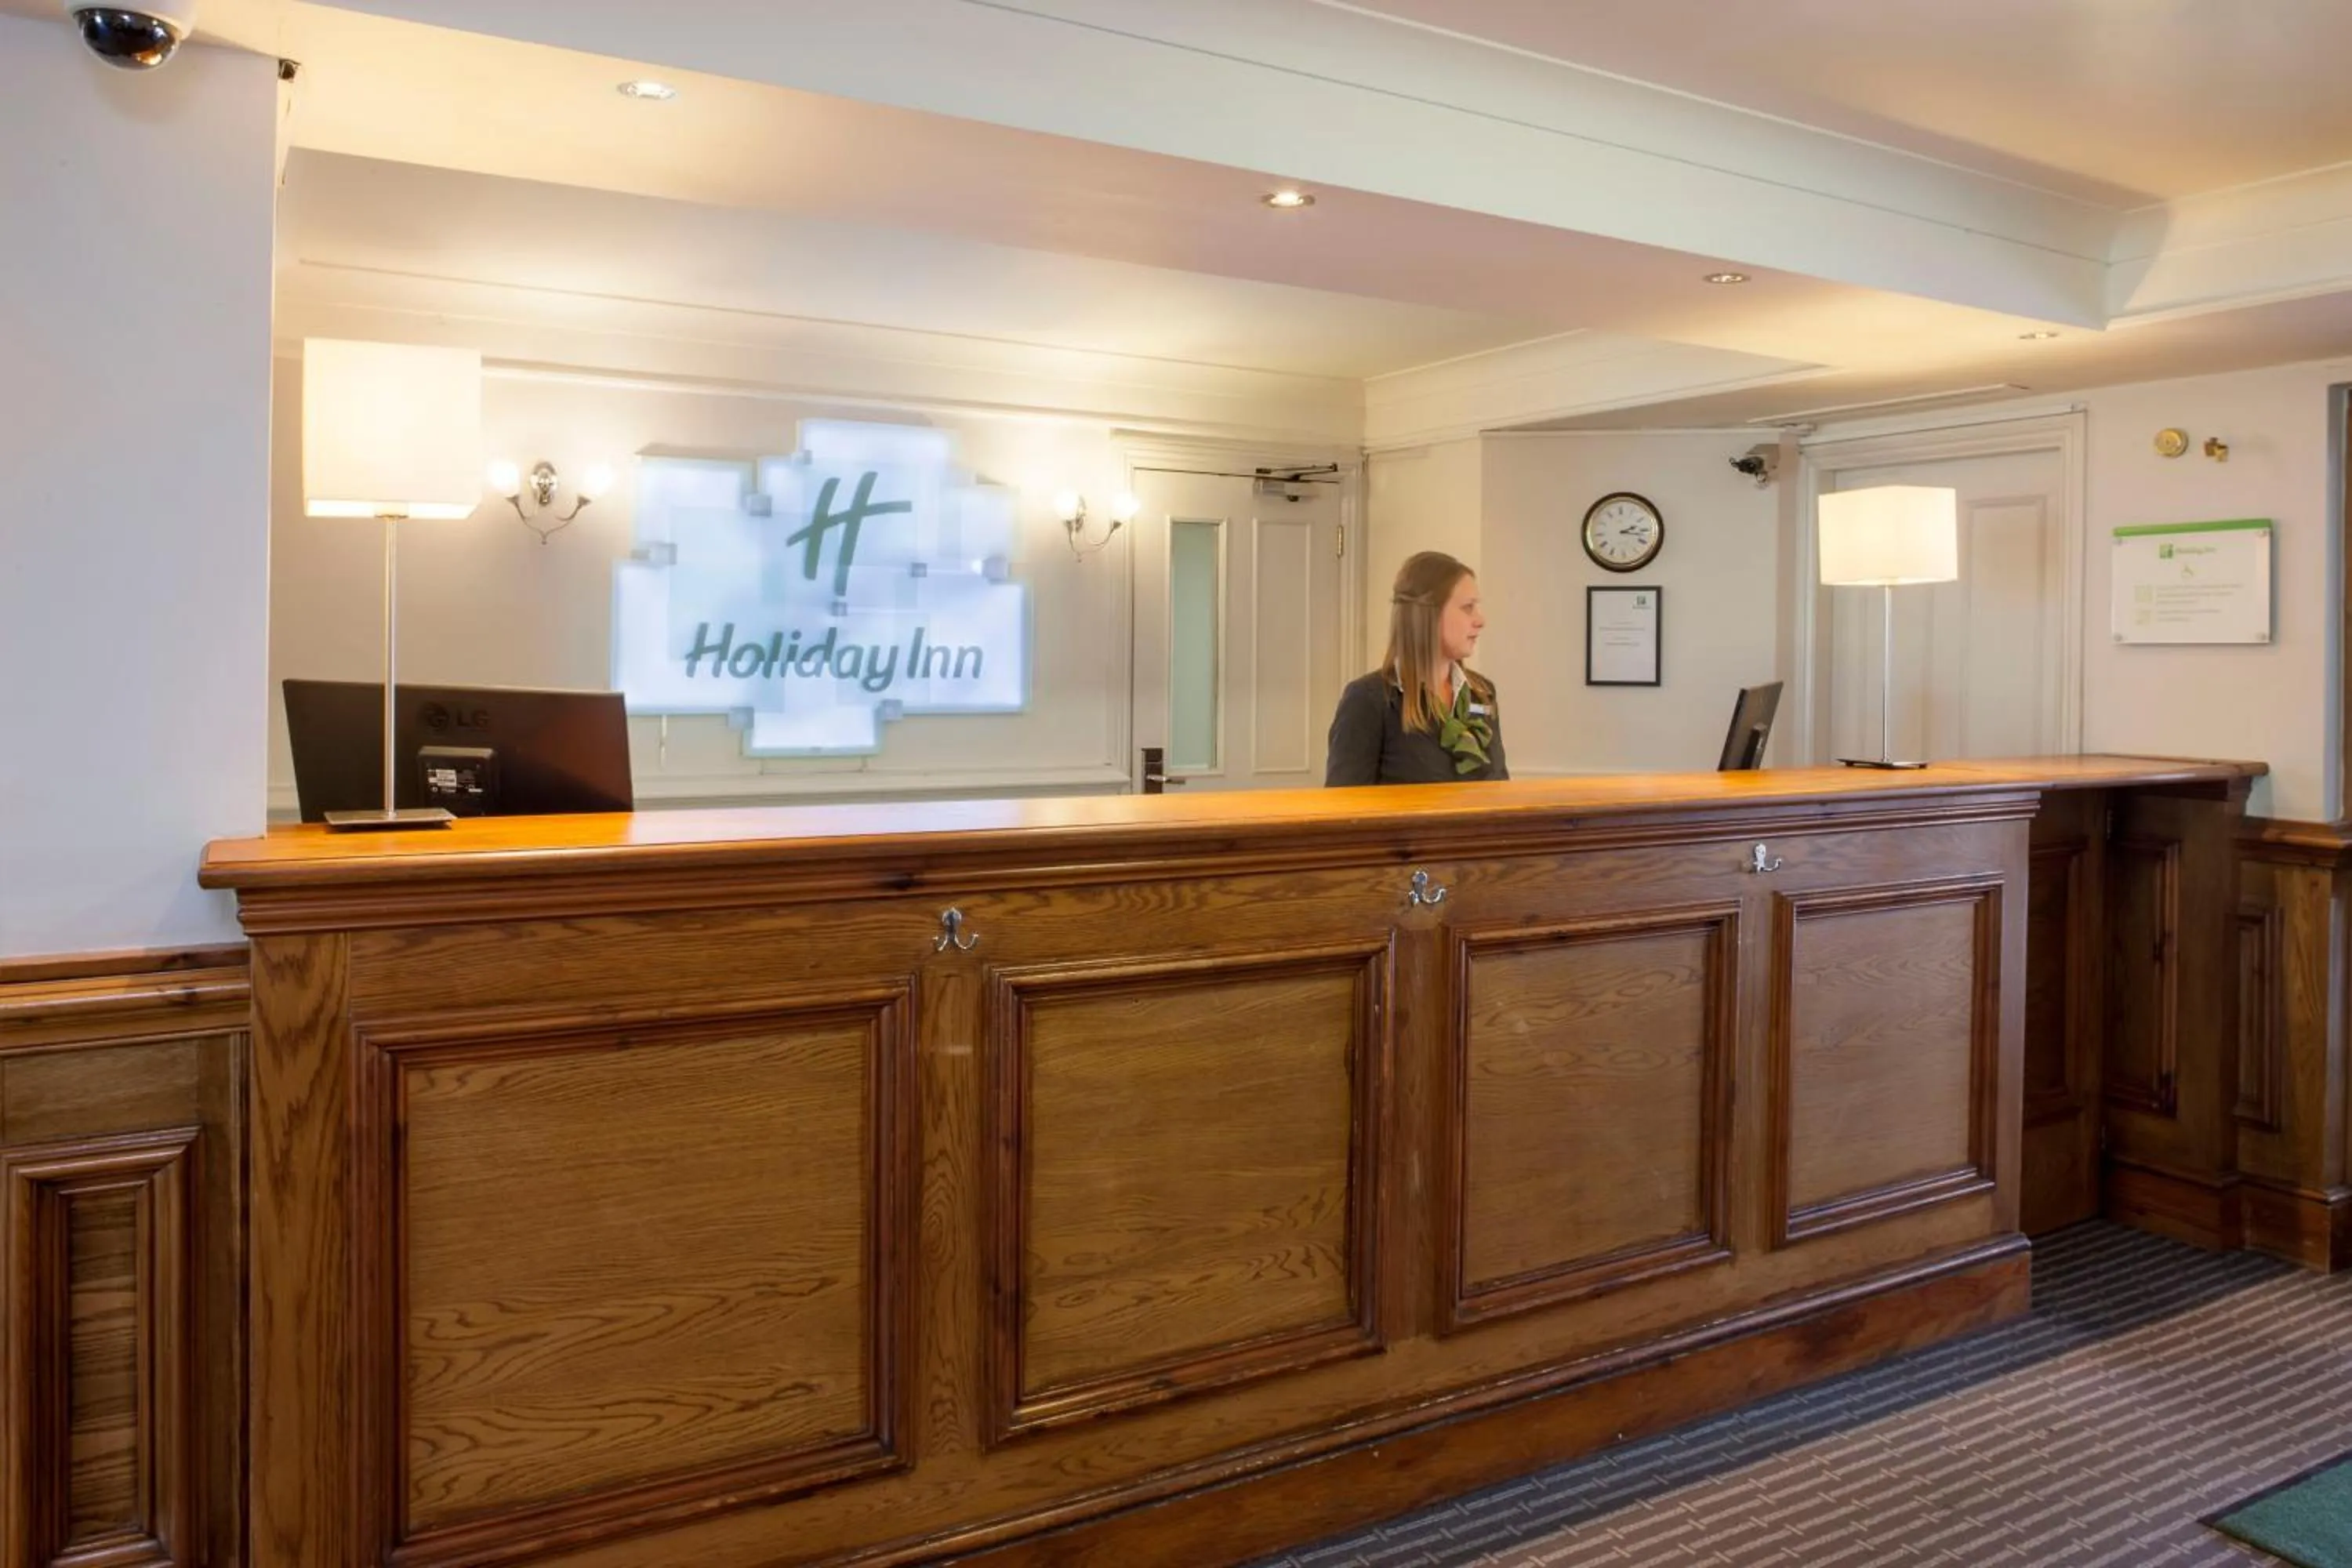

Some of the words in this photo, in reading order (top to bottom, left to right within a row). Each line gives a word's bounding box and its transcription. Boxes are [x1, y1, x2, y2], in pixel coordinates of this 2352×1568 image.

[786, 470, 913, 597] H
[684, 622, 899, 693] Holiday
[906, 626, 984, 680] Inn
[456, 708, 490, 728] LG
